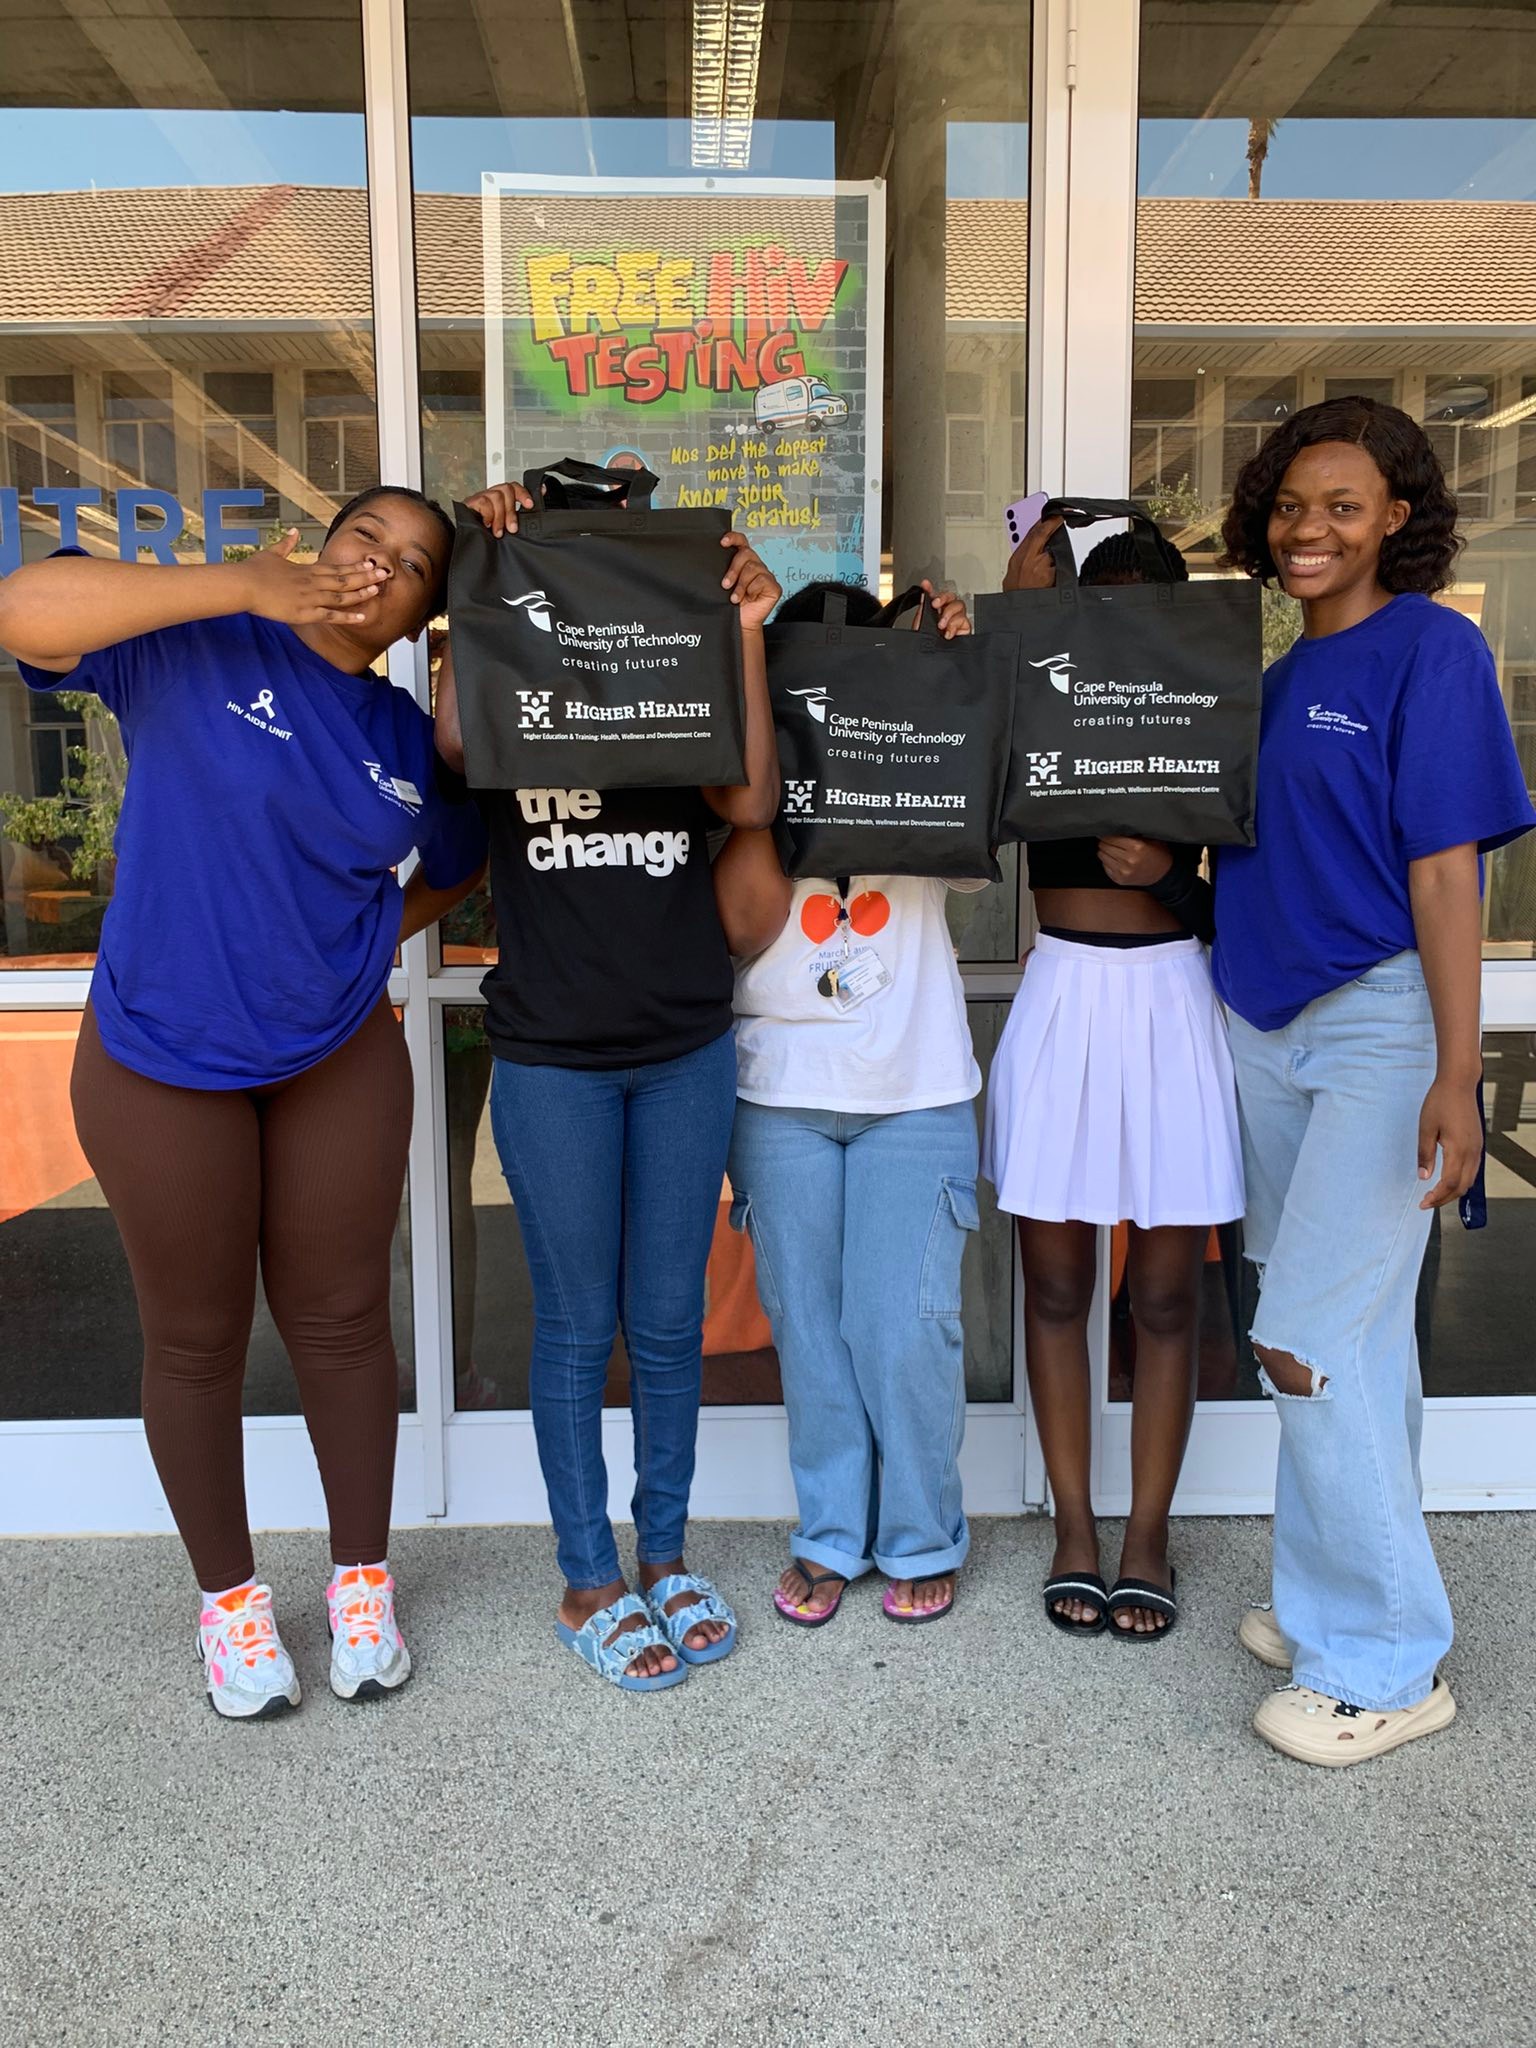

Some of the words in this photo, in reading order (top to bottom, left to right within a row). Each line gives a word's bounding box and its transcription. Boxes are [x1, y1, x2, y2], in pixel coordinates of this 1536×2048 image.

[526, 252, 695, 341] FREE
[671, 446, 699, 465] Mos
[705, 438, 737, 462] Def
[741, 440, 768, 458] the
[775, 436, 827, 460] dopest
[707, 464, 747, 482] move
[754, 461, 770, 479] to
[746, 497, 821, 530] status!
[556, 621, 585, 639] Cape
[588, 621, 645, 637] Peninsula
[558, 634, 613, 653] University
[616, 636, 630, 649] of
[631, 632, 701, 647] Technology
[562, 657, 618, 674] creating
[625, 657, 679, 670] futures
[1074, 681, 1105, 695] Cape
[1108, 681, 1163, 693] Peninsula
[1074, 694, 1131, 708] University
[1134, 694, 1146, 706] of
[1150, 692, 1218, 708] Technology
[226, 701, 244, 715] HIV
[243, 712, 267, 730] AIDS
[268, 725, 293, 741] UNIT
[829, 713, 859, 728] Cape
[862, 717, 914, 732] Peninsula
[1073, 715, 1134, 727] creating
[1141, 714, 1191, 725] futures
[523, 733, 542, 741] Higher
[543, 733, 568, 741] Education
[657, 732, 693, 740] Development
[694, 731, 711, 739] Centre
[829, 726, 883, 745] University
[885, 732, 898, 744] of
[900, 732, 967, 746] Technology
[827, 749, 884, 764] creating
[890, 753, 941, 763] futures
[1030, 789, 1048, 798] Higher
[1049, 788, 1076, 796] Education
[1164, 785, 1200, 794] Development
[515, 788, 602, 824] the
[911, 819, 946, 828] Development
[946, 820, 965, 828] Centre
[527, 823, 690, 877] change
